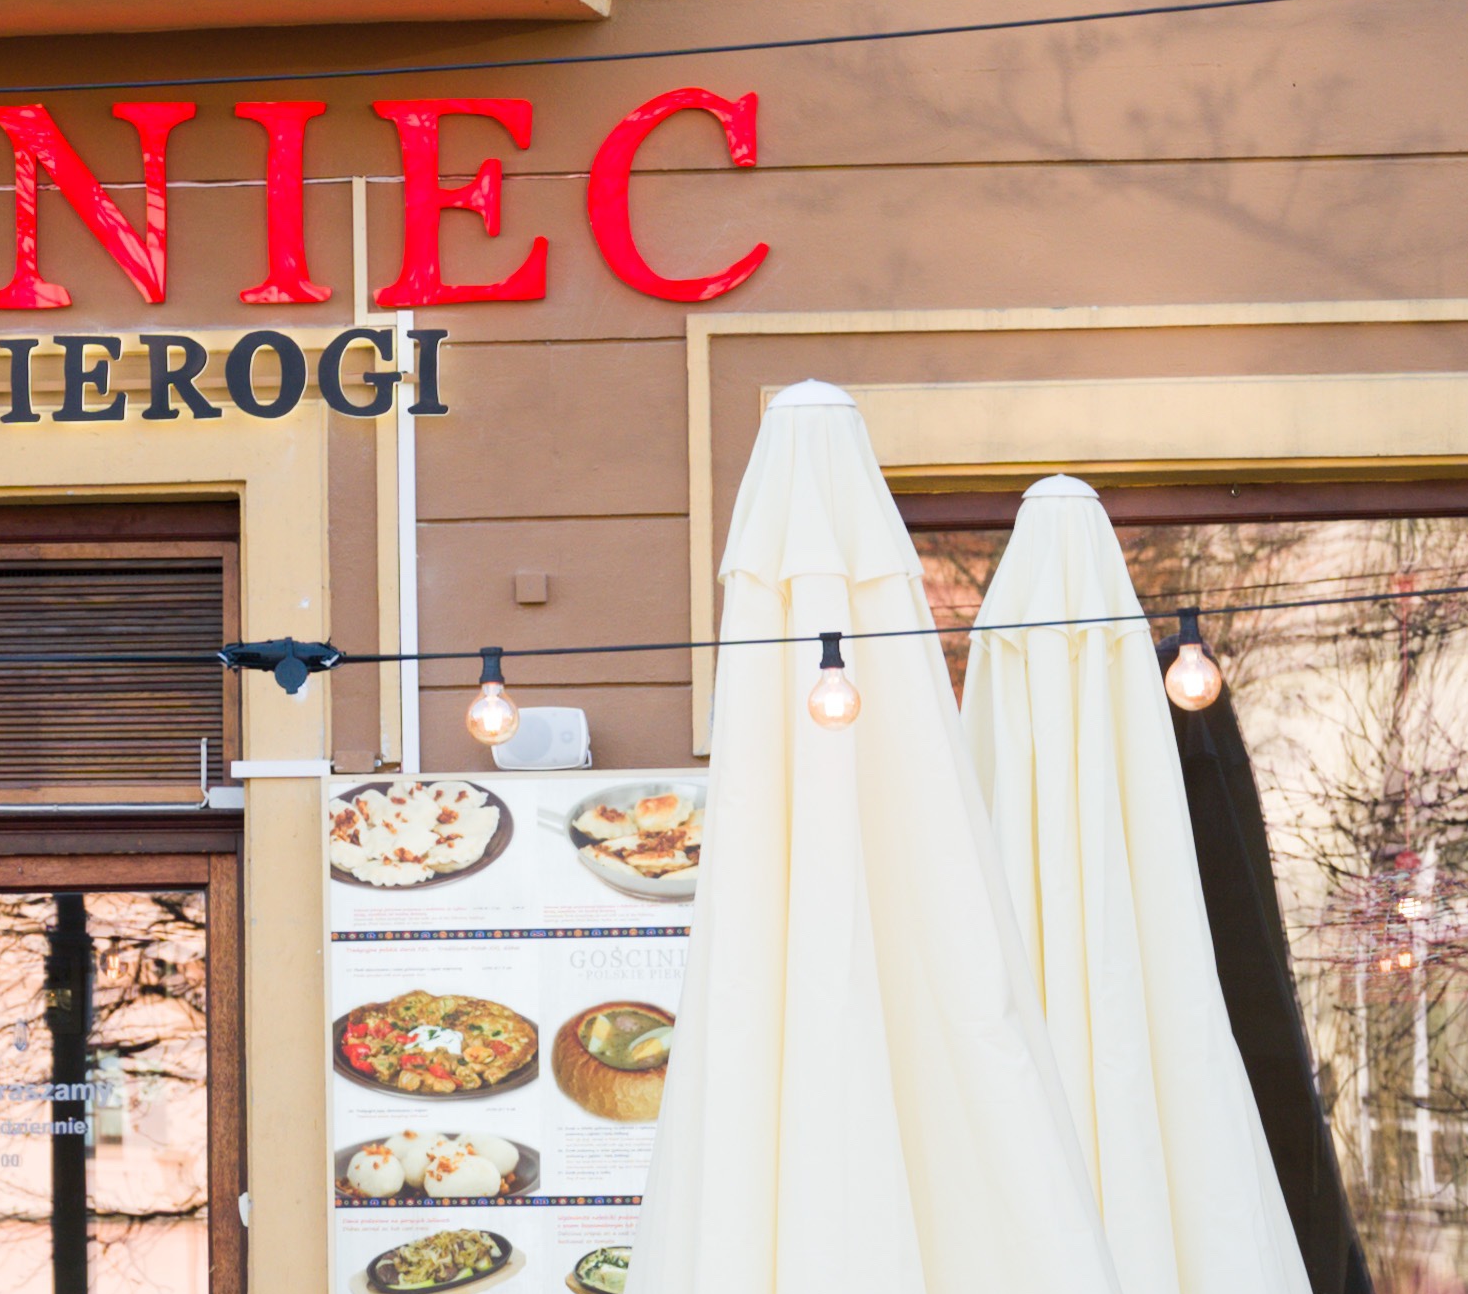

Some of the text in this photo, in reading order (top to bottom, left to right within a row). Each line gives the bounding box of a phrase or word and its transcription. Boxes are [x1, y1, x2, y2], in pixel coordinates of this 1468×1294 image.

[570, 946, 687, 970] GOŚCINI
[585, 969, 641, 981] POLSKIE
[645, 968, 686, 980] PIER
